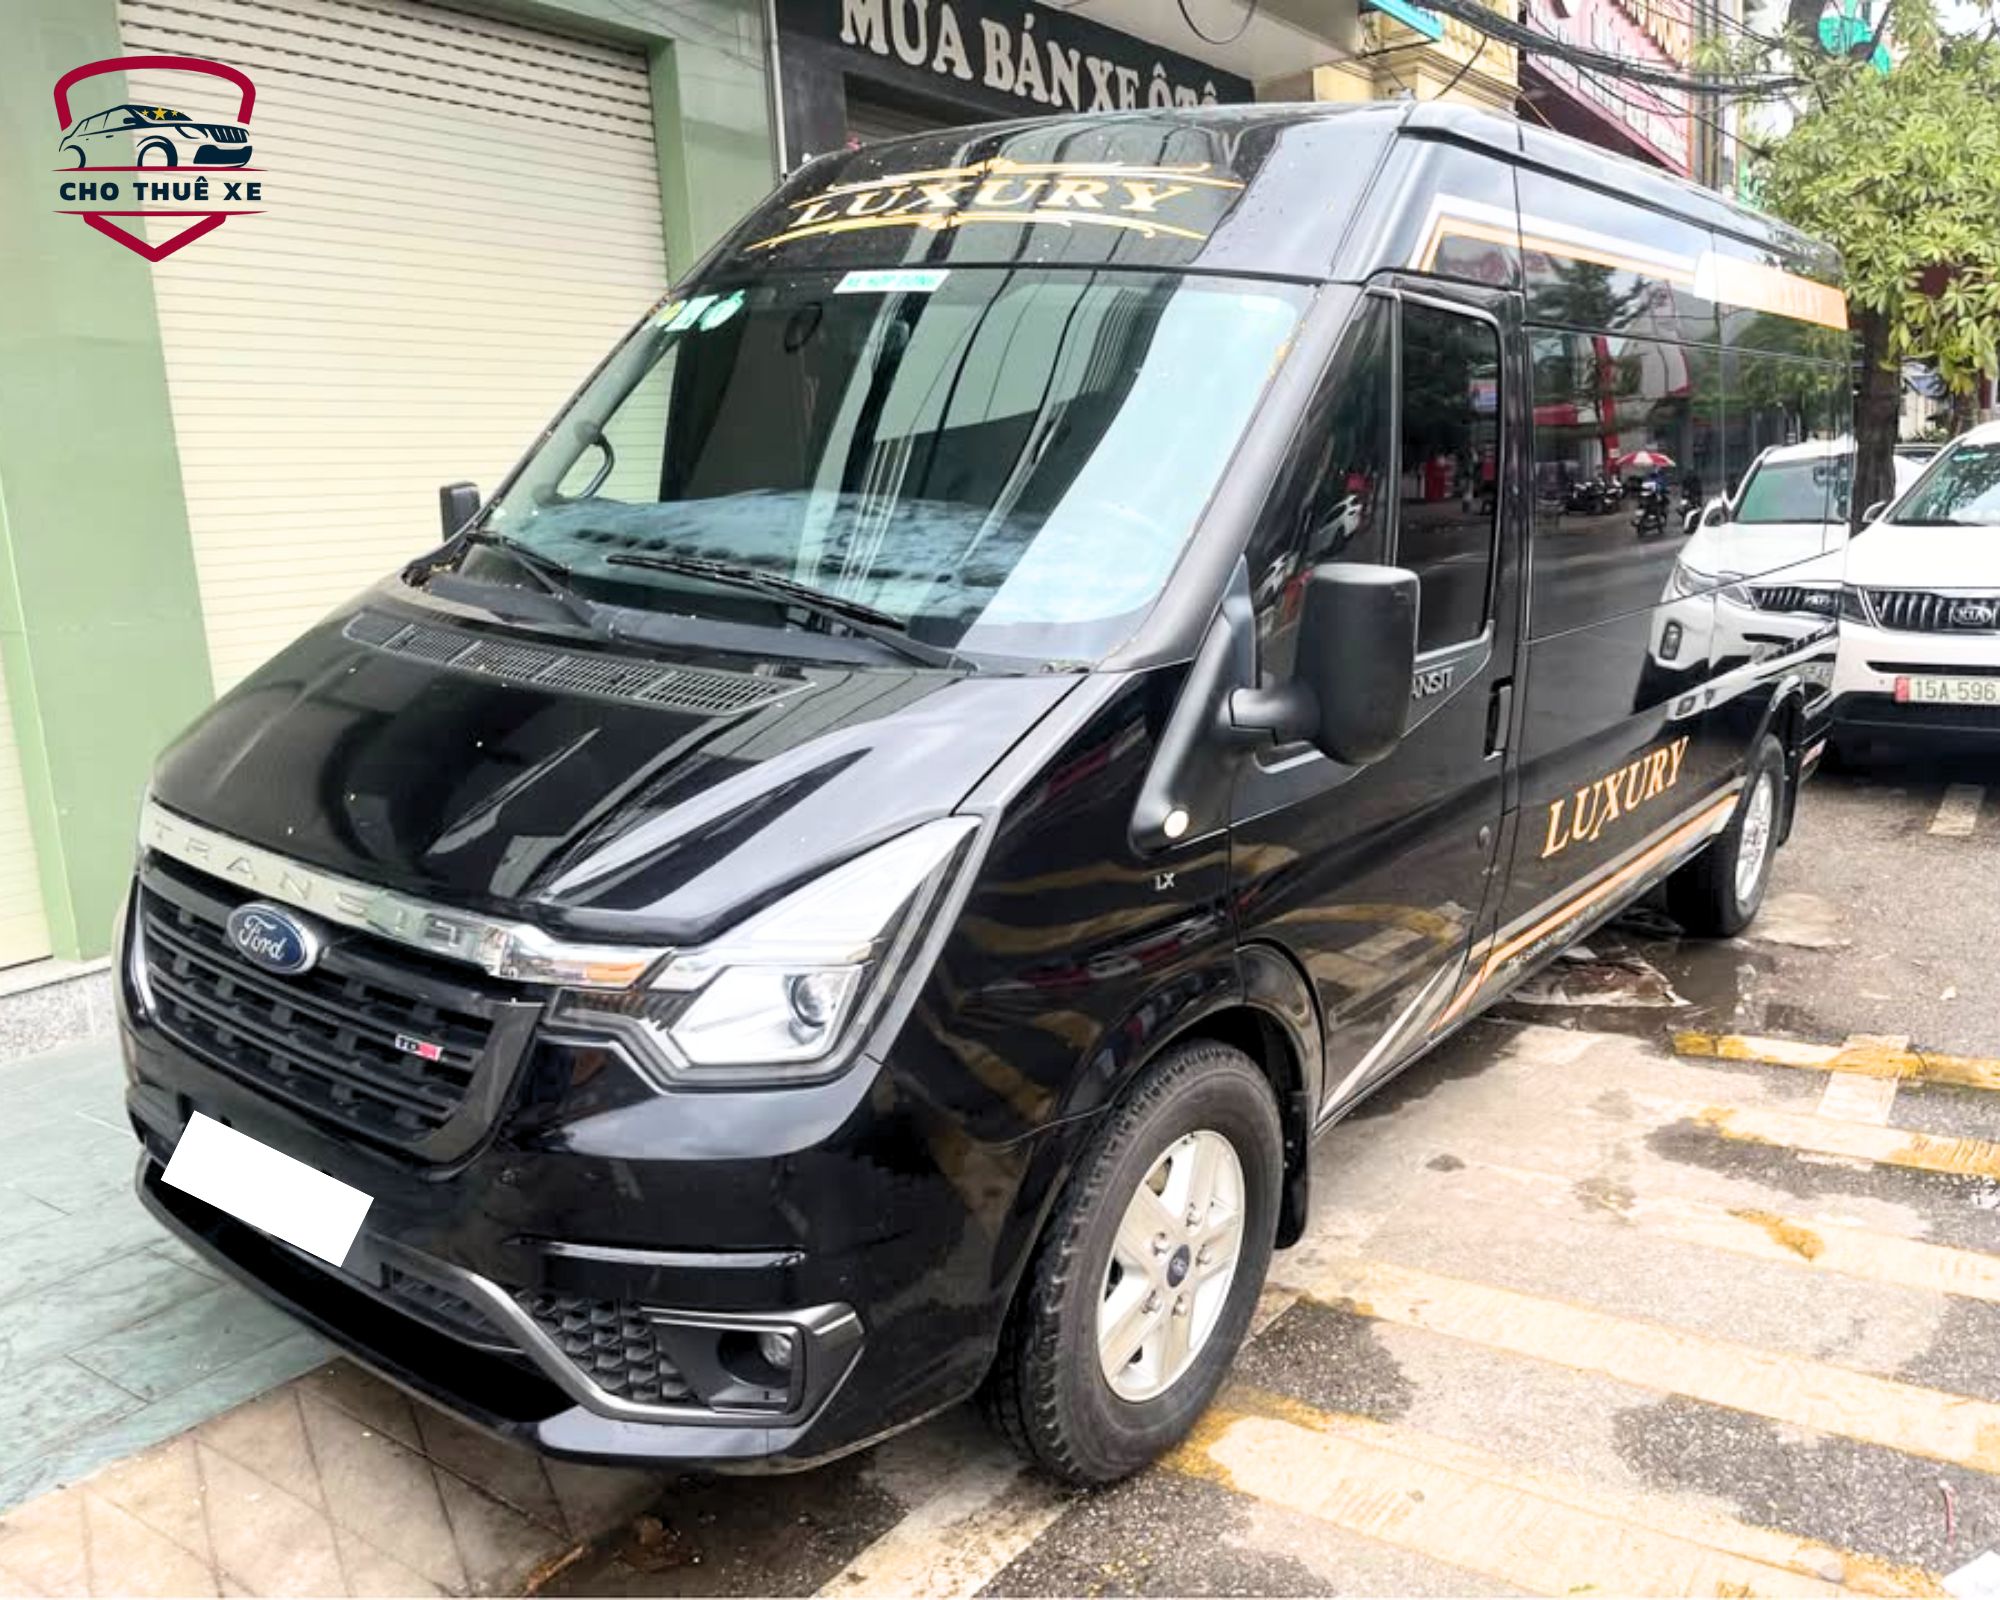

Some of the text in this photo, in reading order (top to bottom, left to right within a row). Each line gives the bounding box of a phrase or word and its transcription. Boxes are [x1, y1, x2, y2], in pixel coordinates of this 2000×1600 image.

[840, 0, 974, 81] MUA
[981, 13, 1080, 112] BÁN
[1084, 56, 1140, 112] XE
[788, 178, 1193, 228] LUXURY
[1411, 667, 1454, 699] ANSIT
[1914, 680, 1997, 702] 15A-596
[1541, 734, 1690, 859] LUXURY
[154, 819, 463, 949] TRANSIT
[1155, 872, 1175, 890] LX
[236, 912, 288, 962] Ford
